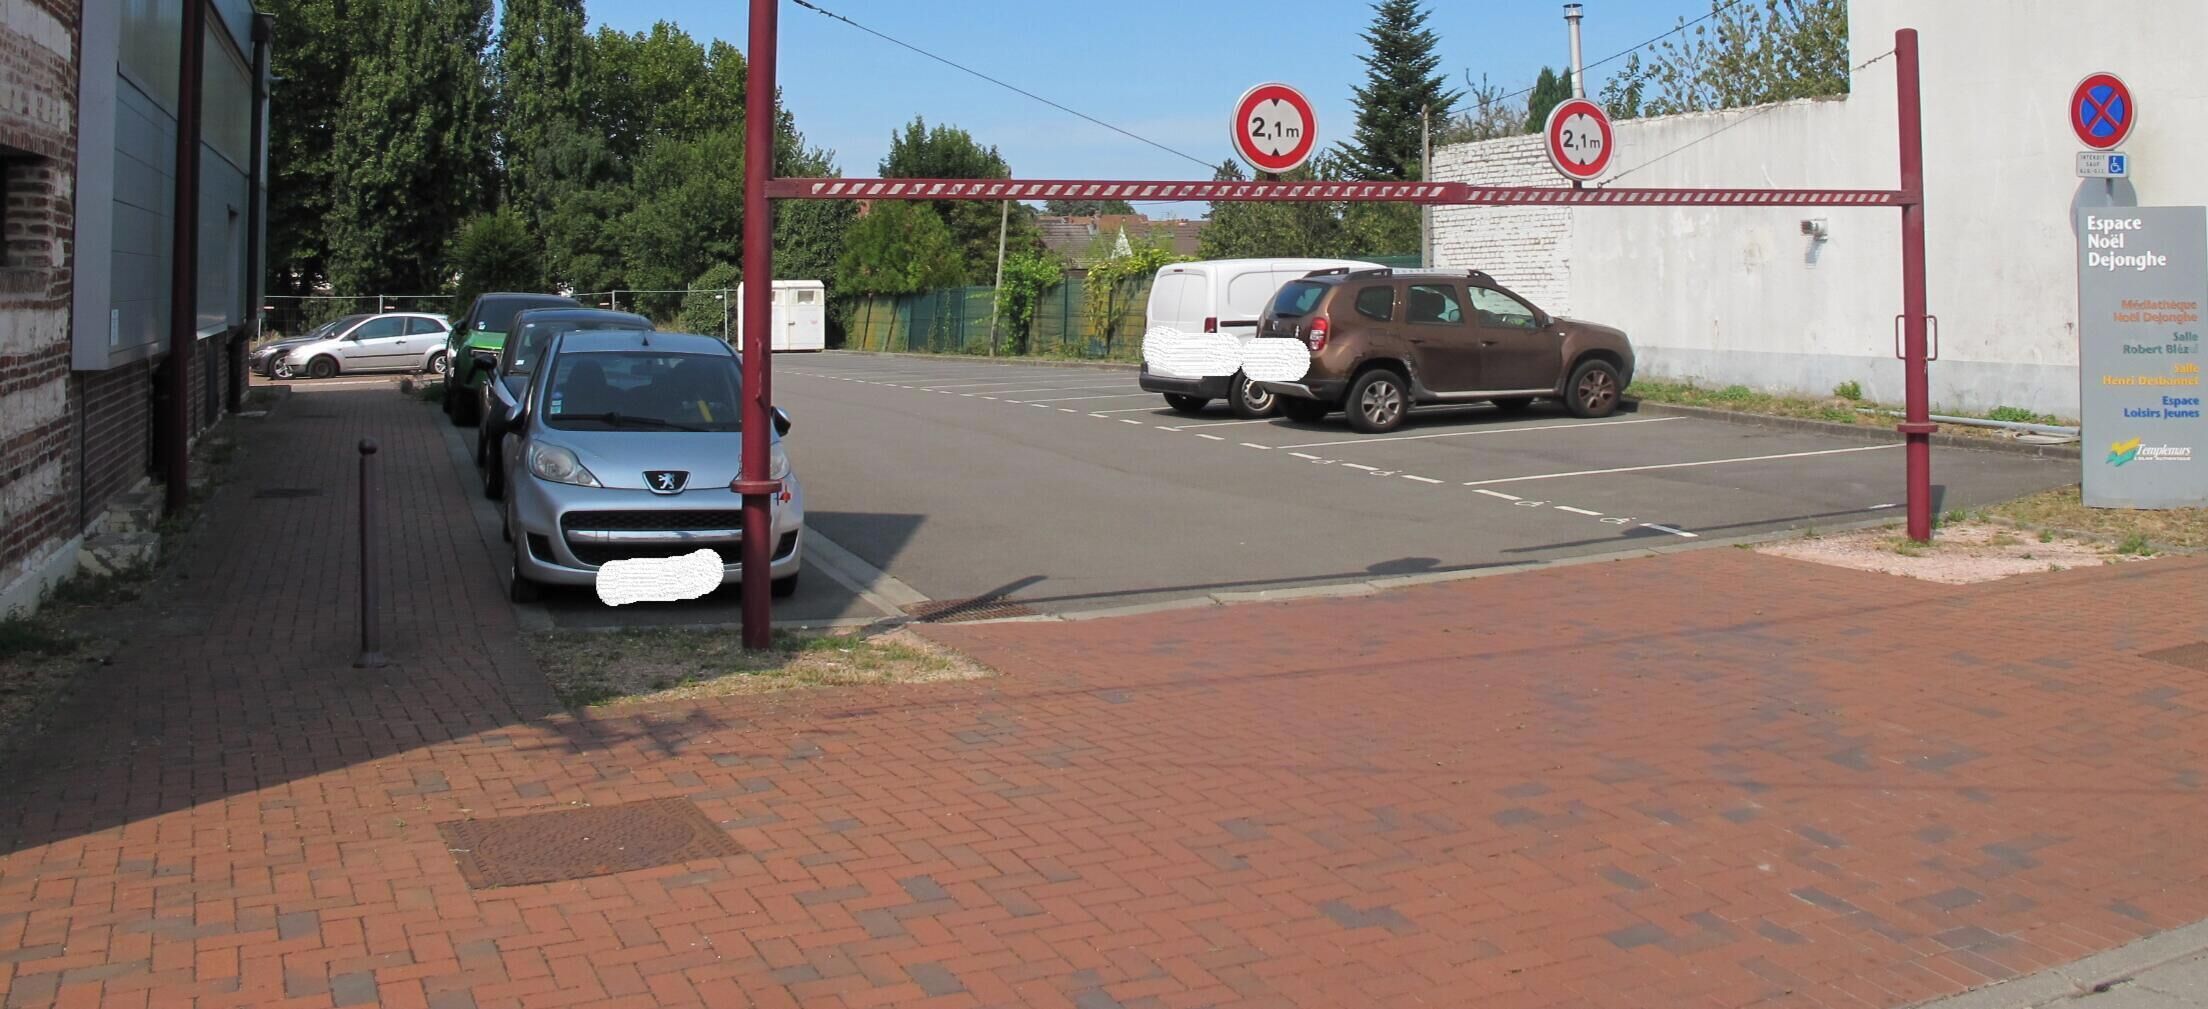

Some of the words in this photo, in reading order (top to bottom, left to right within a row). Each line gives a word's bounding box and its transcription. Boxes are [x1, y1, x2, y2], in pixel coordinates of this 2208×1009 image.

[1252, 116, 1300, 141] 2,1m
[1562, 129, 1601, 151] 2,1m
[2087, 215, 2142, 234] Espace
[2087, 233, 2124, 249] Noël
[2088, 250, 2167, 271] Dejonghe
[2143, 312, 2199, 325] Dejonghe
[2173, 331, 2199, 341] Salle
[2123, 344, 2162, 354] Robert
[2175, 363, 2199, 374] Salle
[2162, 395, 2199, 408] Espace
[2124, 408, 2161, 418] Loisirs
[2164, 408, 2200, 419] Jeunes
[2136, 444, 2192, 459] Templemars
